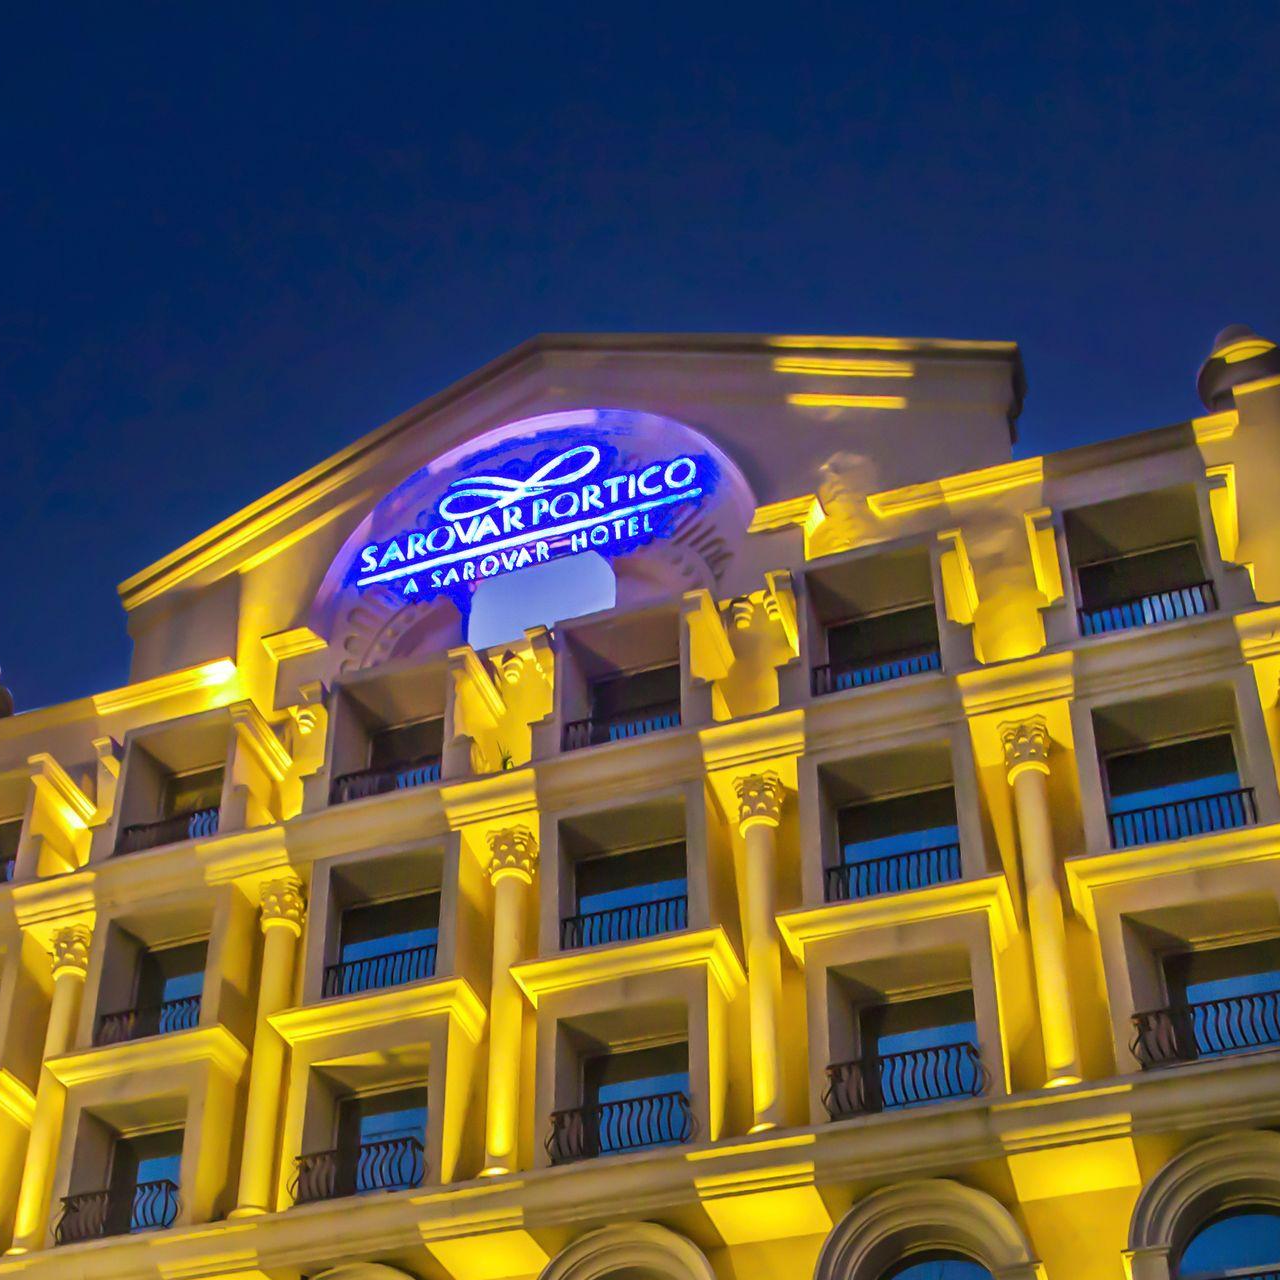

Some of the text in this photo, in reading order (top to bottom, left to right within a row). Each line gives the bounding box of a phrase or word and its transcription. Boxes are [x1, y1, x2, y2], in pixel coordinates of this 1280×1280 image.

[360, 457, 697, 573] SAROVAR PORTICO
[403, 513, 654, 595] A SAROVAR HOTEL
